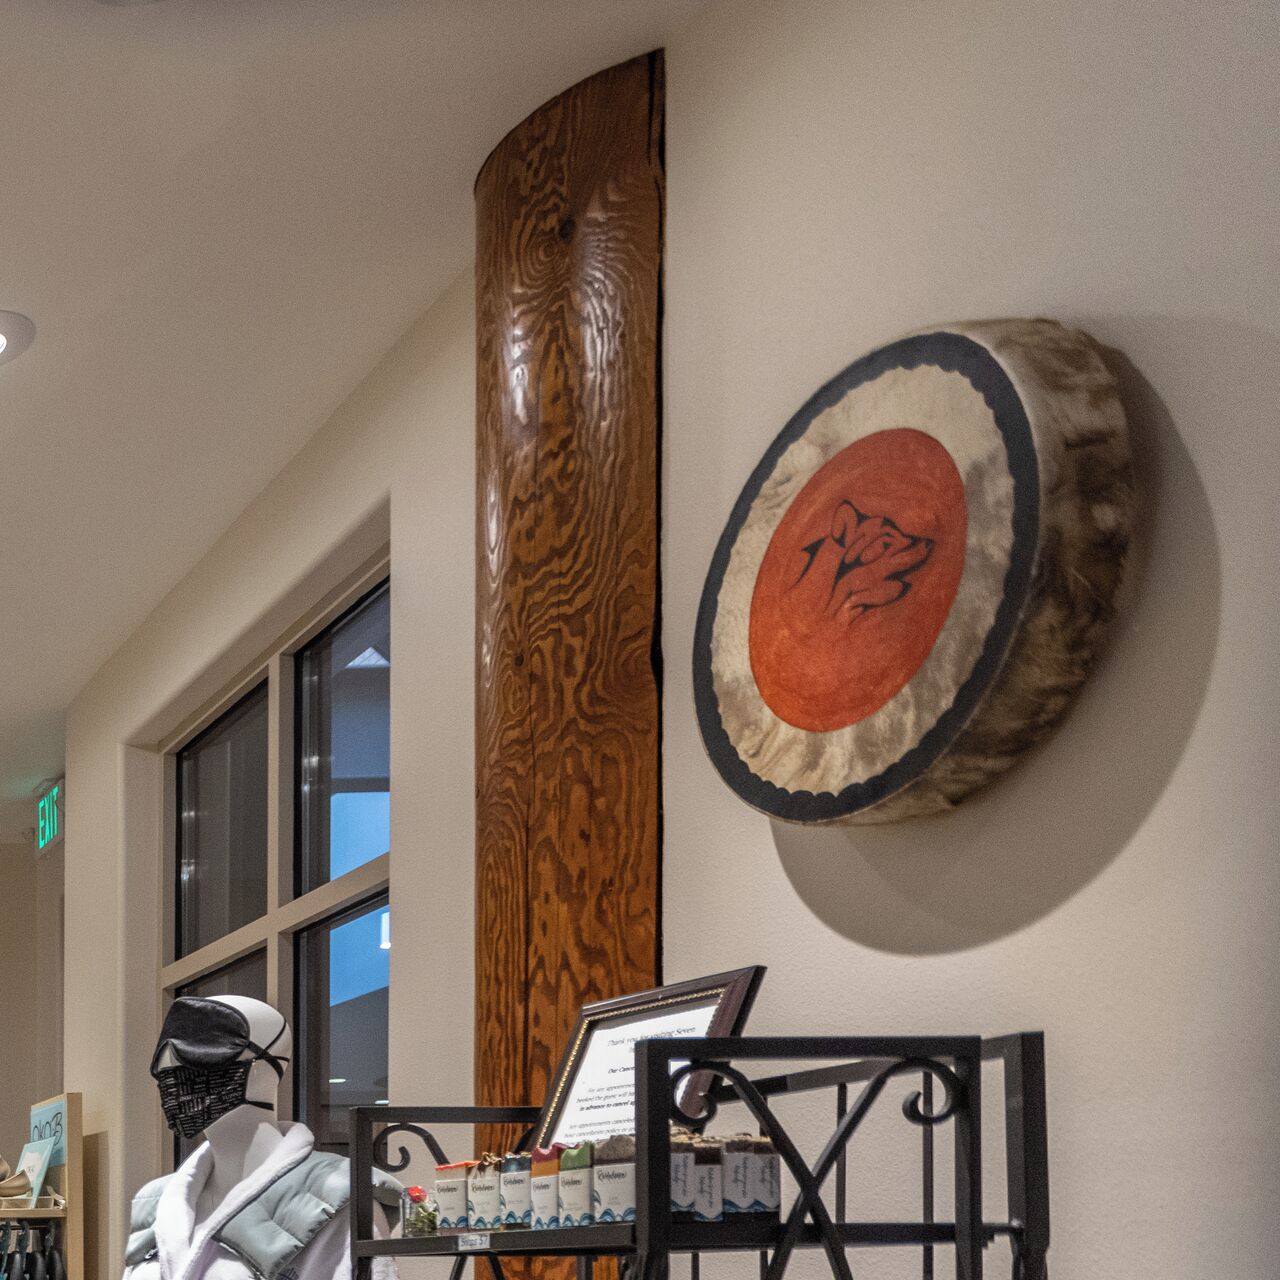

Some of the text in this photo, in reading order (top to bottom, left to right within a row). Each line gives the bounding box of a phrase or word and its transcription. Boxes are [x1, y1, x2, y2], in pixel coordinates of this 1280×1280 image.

[38, 785, 59, 849] EXIT
[607, 1038, 625, 1047] Thank
[676, 1026, 696, 1036] Seven
[607, 1067, 617, 1075] Our
[585, 1103, 606, 1111] advance
